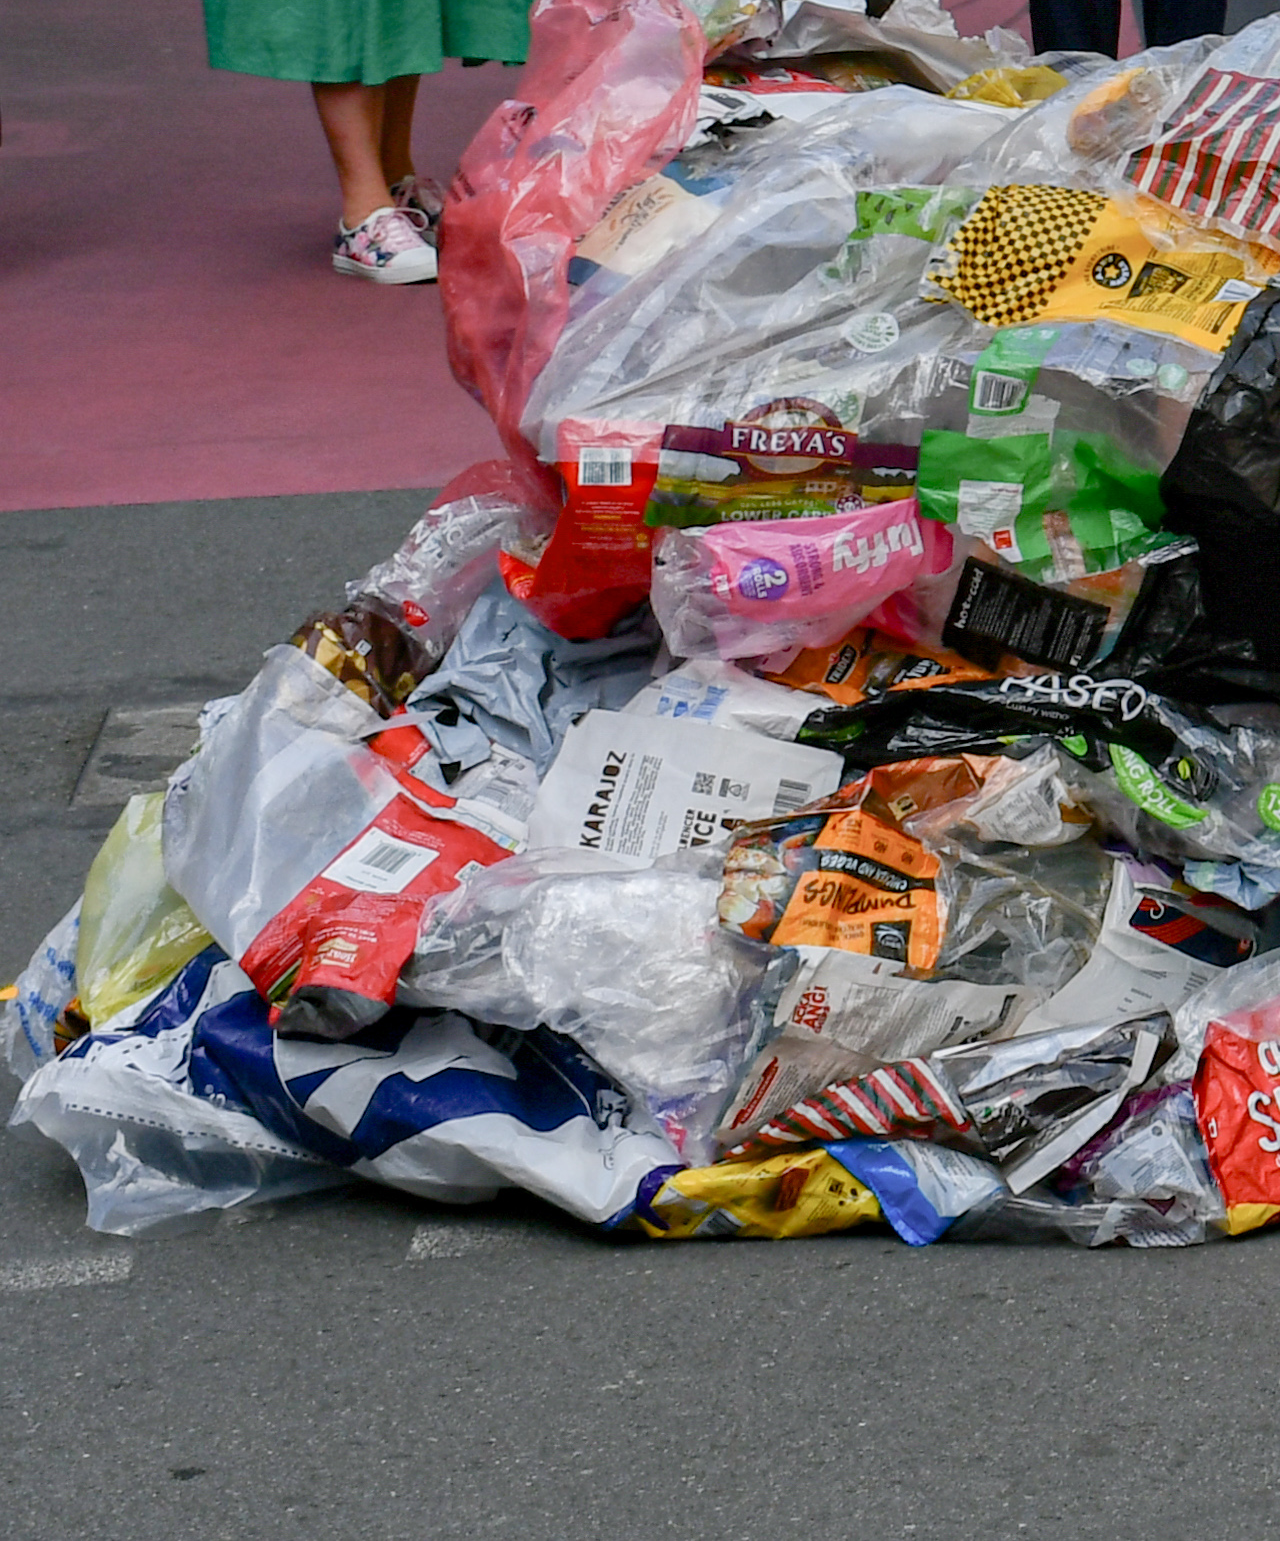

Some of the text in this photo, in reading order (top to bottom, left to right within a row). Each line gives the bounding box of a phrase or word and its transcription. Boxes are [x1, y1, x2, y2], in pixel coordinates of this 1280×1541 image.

[730, 426, 848, 458] FREYA'S
[721, 508, 784, 522] LOWER
[752, 567, 769, 600] ROLLS
[764, 570, 788, 589] 2
[827, 646, 857, 685] TRIDENT
[1000, 674, 1148, 722] PASEO
[1006, 703, 1040, 717] Luxury
[578, 749, 629, 850] KARAJOZ
[1139, 776, 1178, 816] ROLL
[855, 861, 878, 879] AND
[875, 868, 910, 893] CHICKEN
[803, 876, 918, 912] DUMPLINGS
